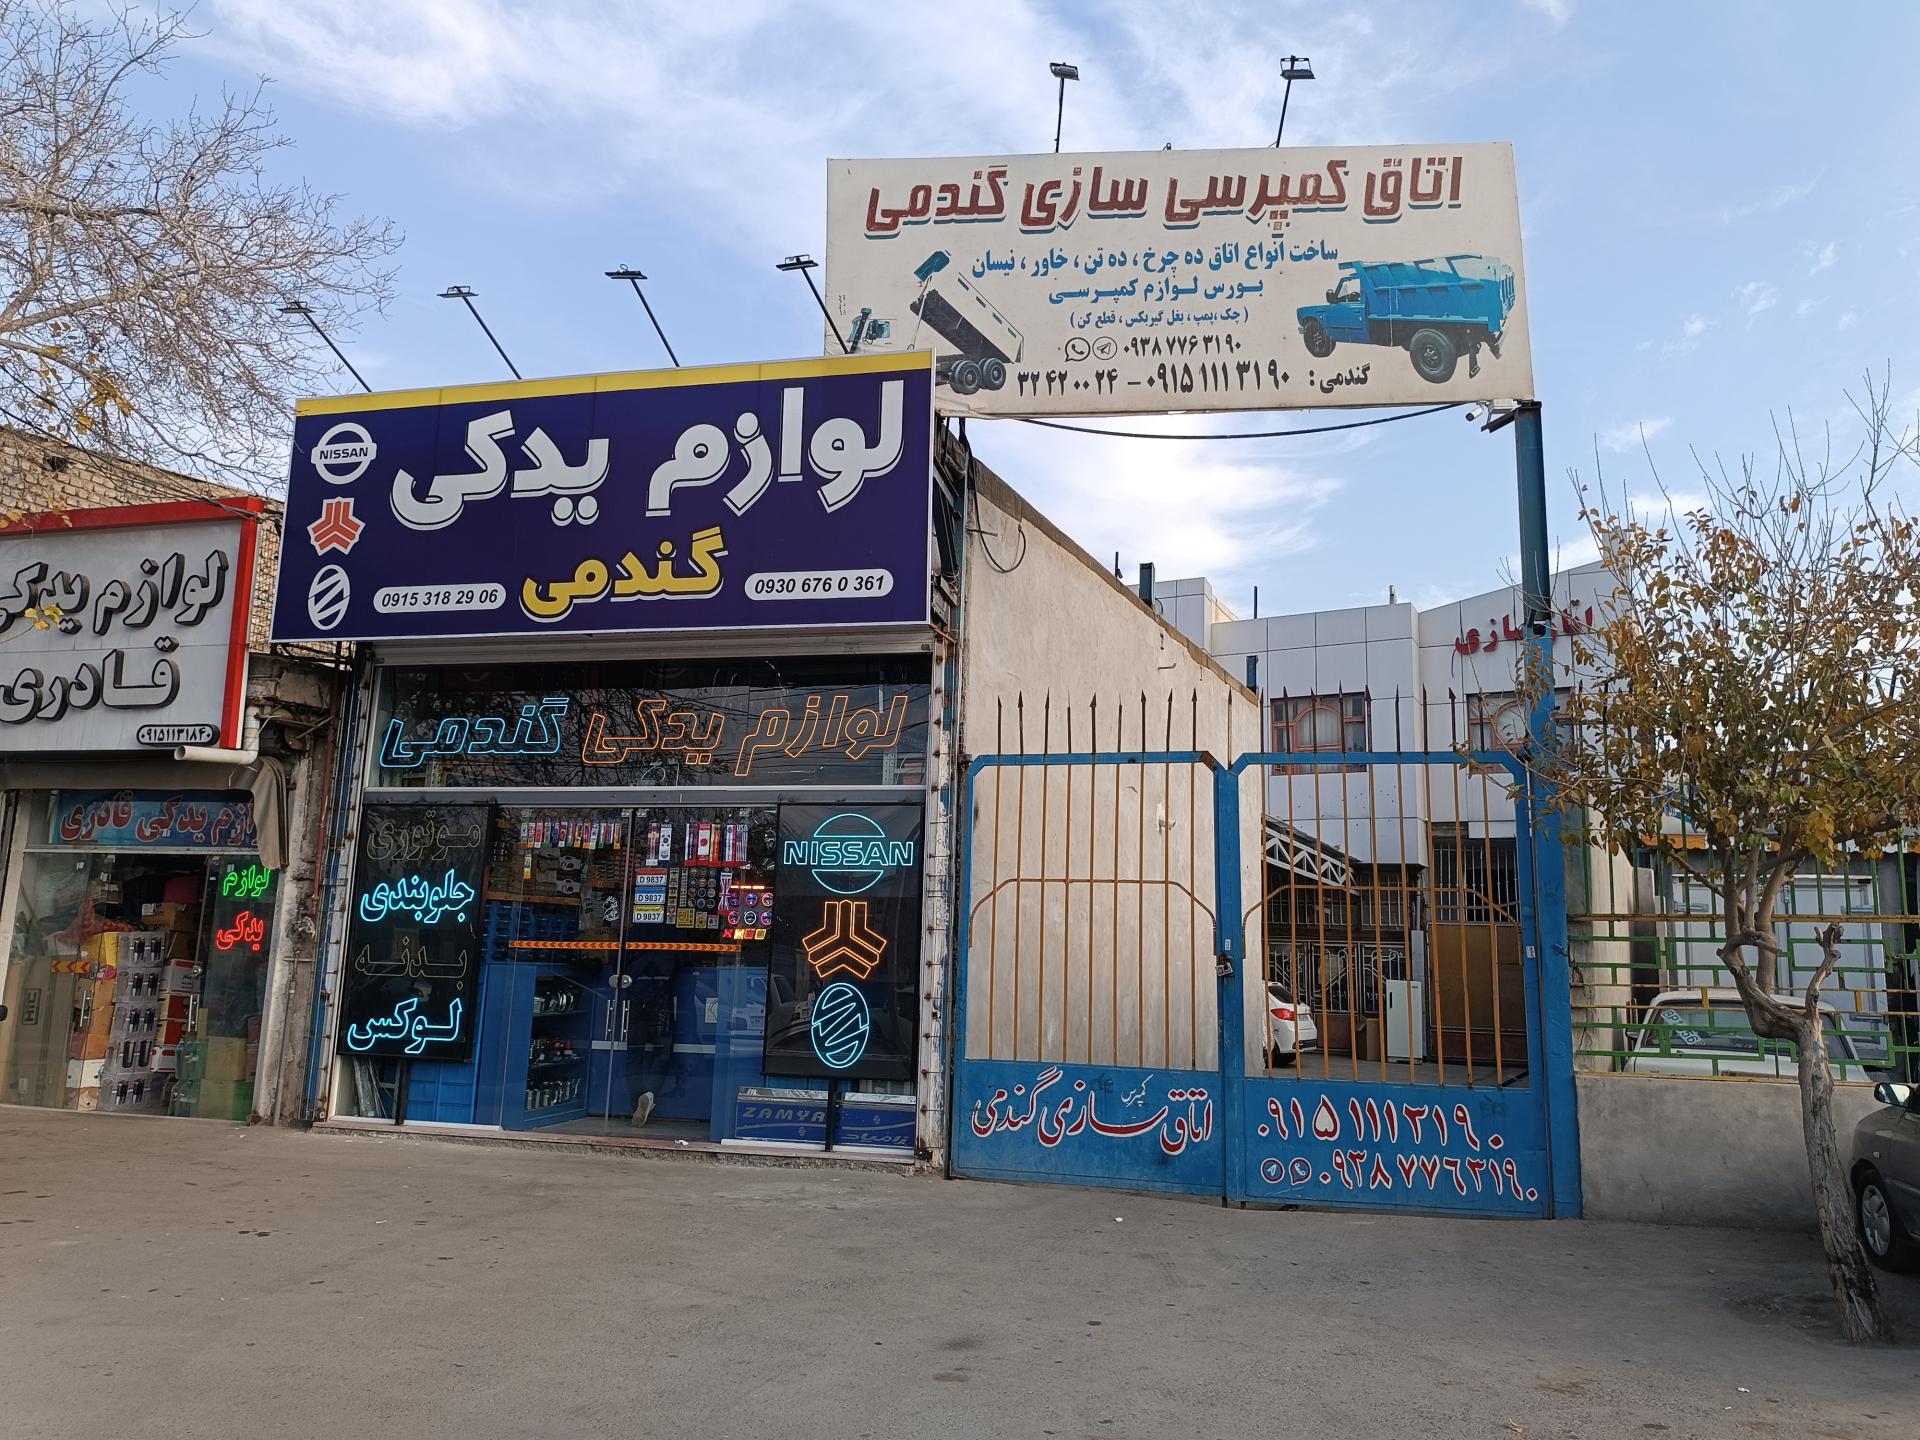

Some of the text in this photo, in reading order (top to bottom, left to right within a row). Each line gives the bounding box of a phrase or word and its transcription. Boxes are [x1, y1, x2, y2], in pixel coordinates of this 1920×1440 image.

[864, 156, 1463, 240] اتاق کمپرسی سازی گندمی
[971, 250, 1015, 279] نیسان
[1108, 251, 1127, 267] ده
[1184, 249, 1204, 265] ده
[1208, 242, 1239, 271] اتاق
[1244, 241, 1285, 270] انواع
[1289, 239, 1339, 262] ساخت
[1048, 276, 1264, 305] بورس لوازم کمپرسی
[1095, 311, 1116, 328] قطع
[1167, 310, 1184, 325] بغل
[318, 447, 370, 461] NISSAN
[391, 379, 904, 530] لوازم یدکی
[518, 526, 728, 623] گندمی
[754, 576, 796, 594] 0930
[800, 575, 831, 593] 676
[853, 574, 884, 591] 361
[93, 550, 228, 635] لوازم
[381, 588, 498, 608] 0915 318 29 06
[0, 636, 180, 724] قادری
[379, 696, 907, 776] لوازم یدکی گندمی
[60, 791, 132, 841] قادری
[135, 795, 207, 842] یدکی
[367, 810, 480, 860] موتوری
[784, 841, 913, 866] NISSAN
[223, 865, 270, 897] لوازم
[646, 876, 664, 884] 9837
[360, 868, 474, 923] جلوبندی
[645, 894, 663, 902] 9837
[216, 911, 264, 950] یدکی
[643, 912, 661, 920] 9837
[355, 936, 467, 990] بدنه
[348, 998, 462, 1054] لوکس
[743, 1106, 827, 1122] ZAMYA
[972, 1066, 1213, 1155] اتاق سازی گندمی
